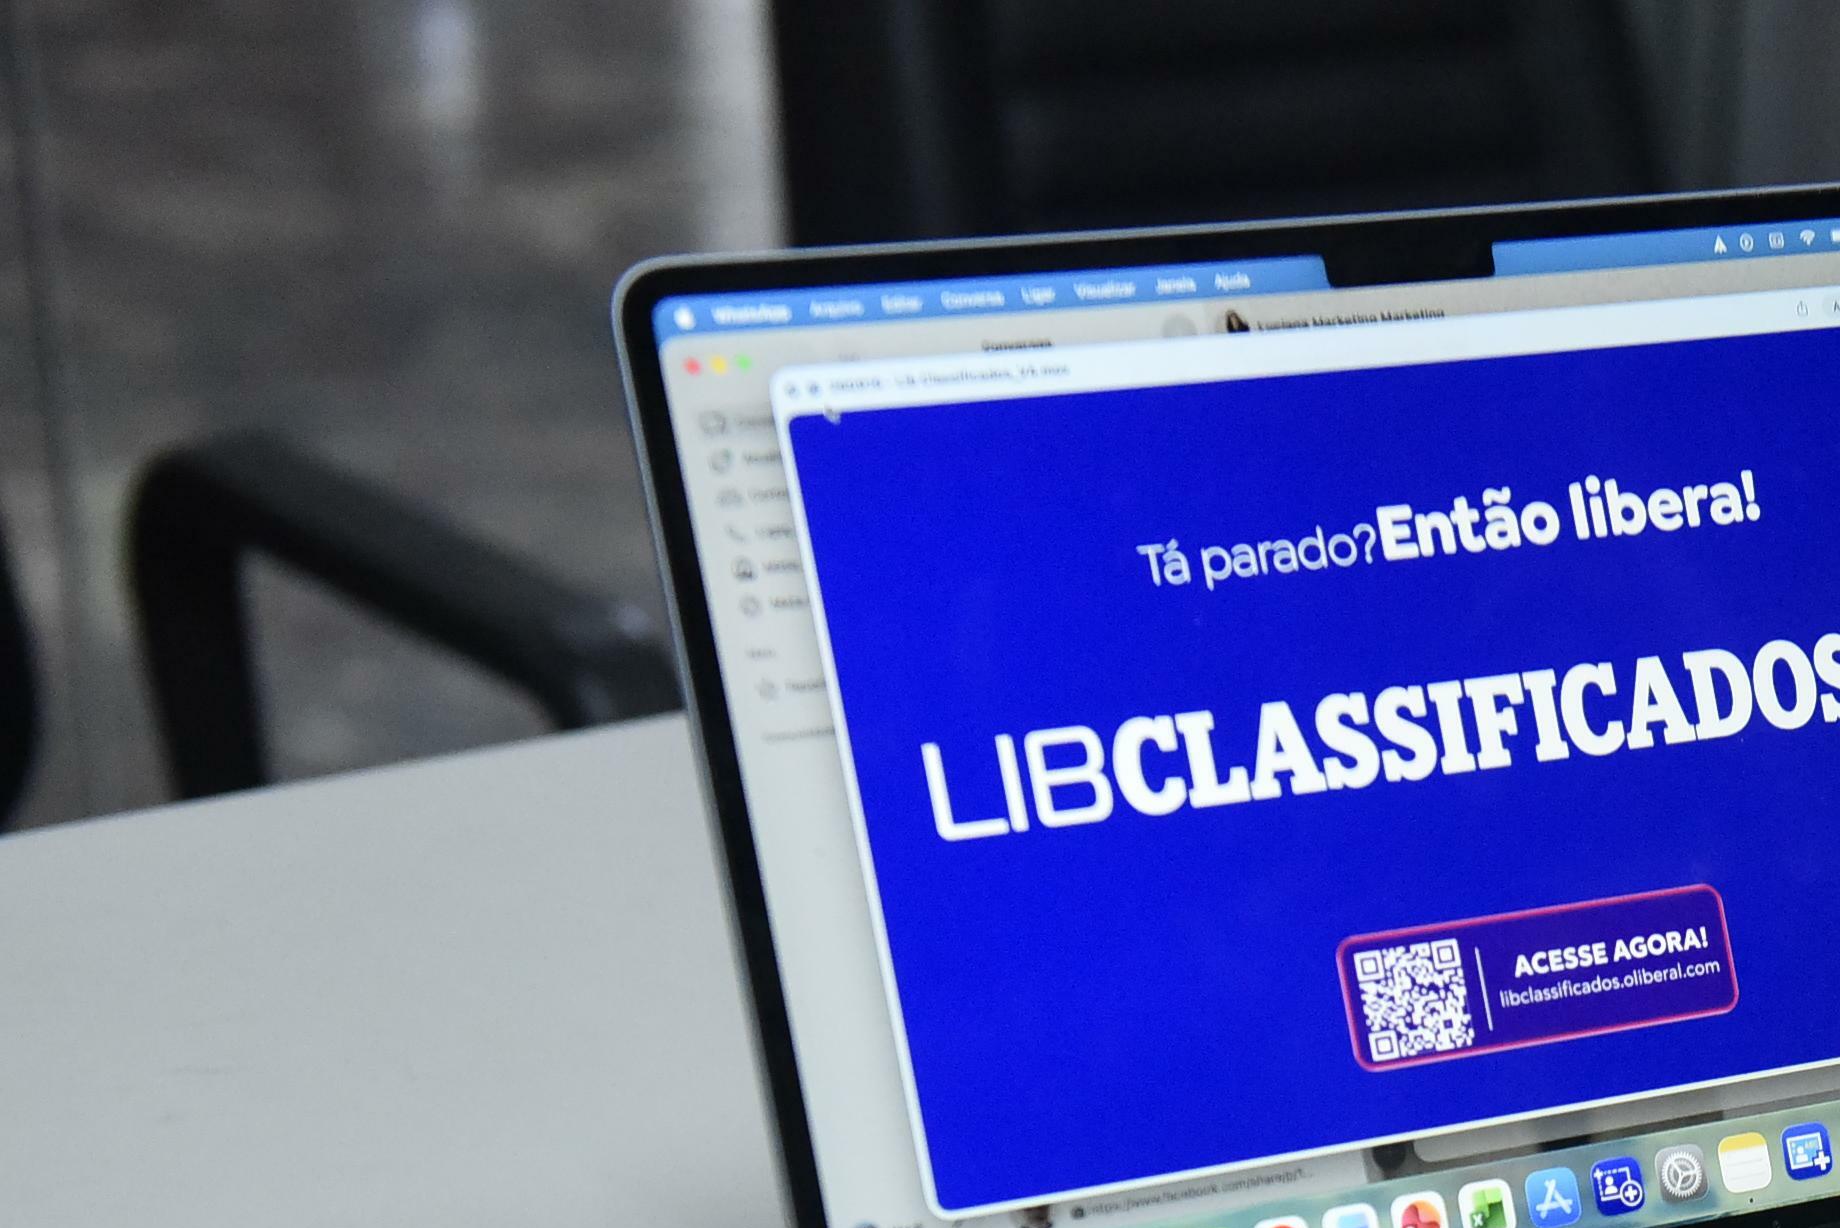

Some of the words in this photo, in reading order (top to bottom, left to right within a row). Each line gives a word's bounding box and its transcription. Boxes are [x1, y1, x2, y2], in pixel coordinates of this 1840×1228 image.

[1136, 539, 1192, 587] Tá
[1569, 470, 1761, 540] libera!
[1514, 941, 1609, 979] ACESSE
[1613, 926, 1710, 963] AGORA!
[1500, 960, 1721, 1008] libclassificados.oliberal.com
